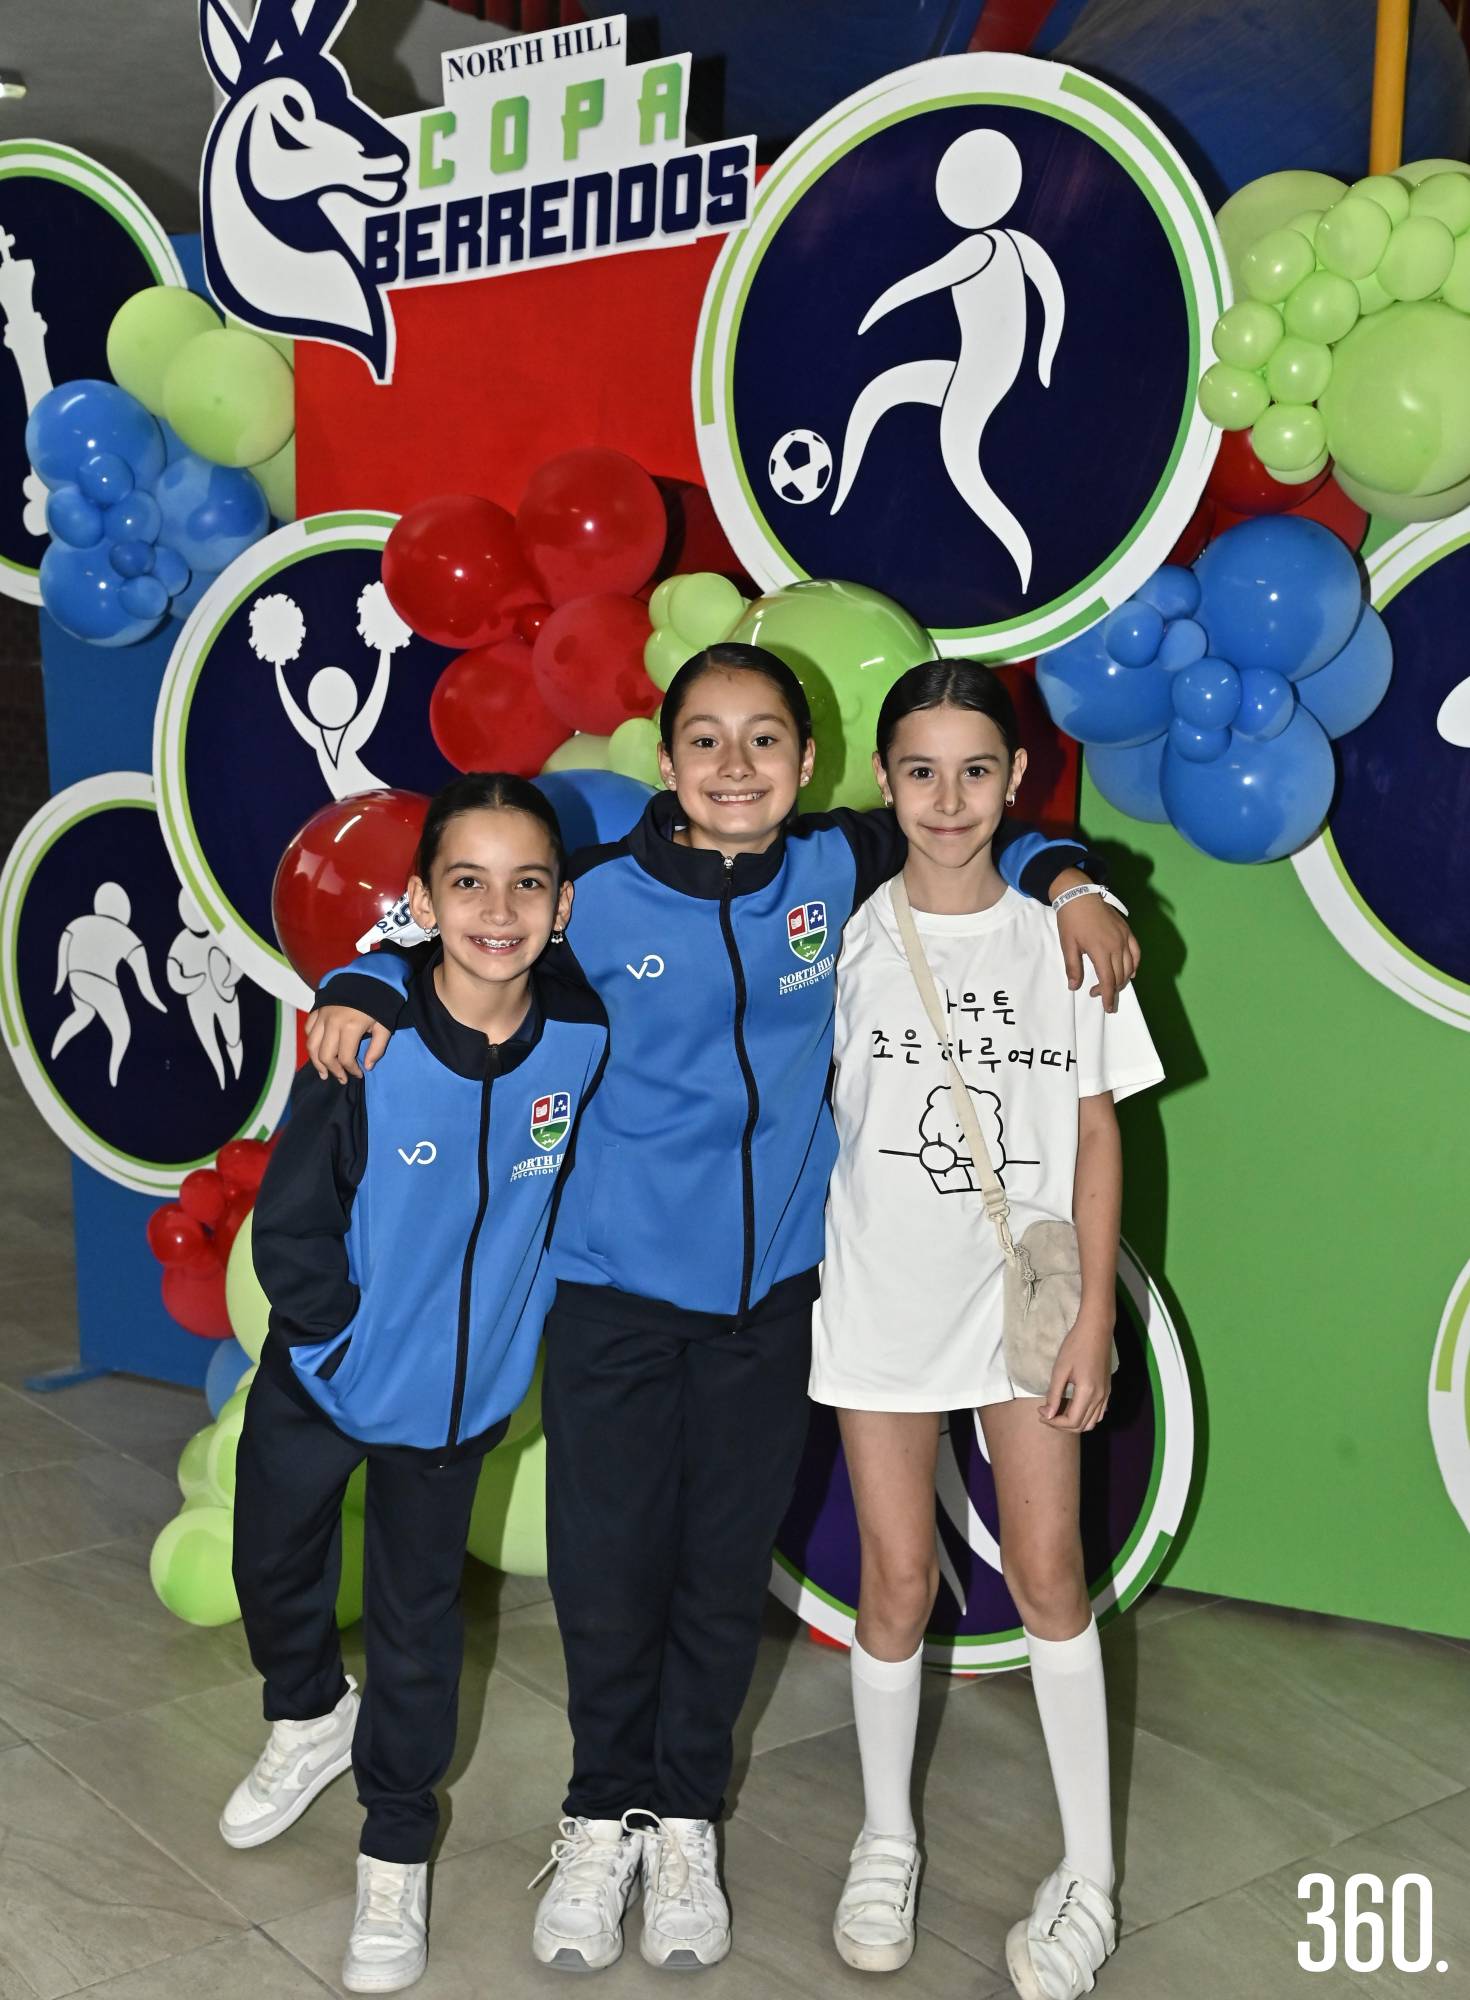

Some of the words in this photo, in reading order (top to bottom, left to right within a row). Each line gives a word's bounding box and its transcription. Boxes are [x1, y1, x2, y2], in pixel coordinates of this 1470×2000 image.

[447, 36, 545, 83] NORTH
[552, 21, 623, 60] HILL
[418, 62, 684, 190] COPA
[364, 144, 751, 286] BERRENDOS
[778, 964, 816, 987] NORTH
[779, 977, 819, 996] EDUCATION
[871, 1029, 922, 1065] 조은
[511, 1154, 553, 1174] NORTH
